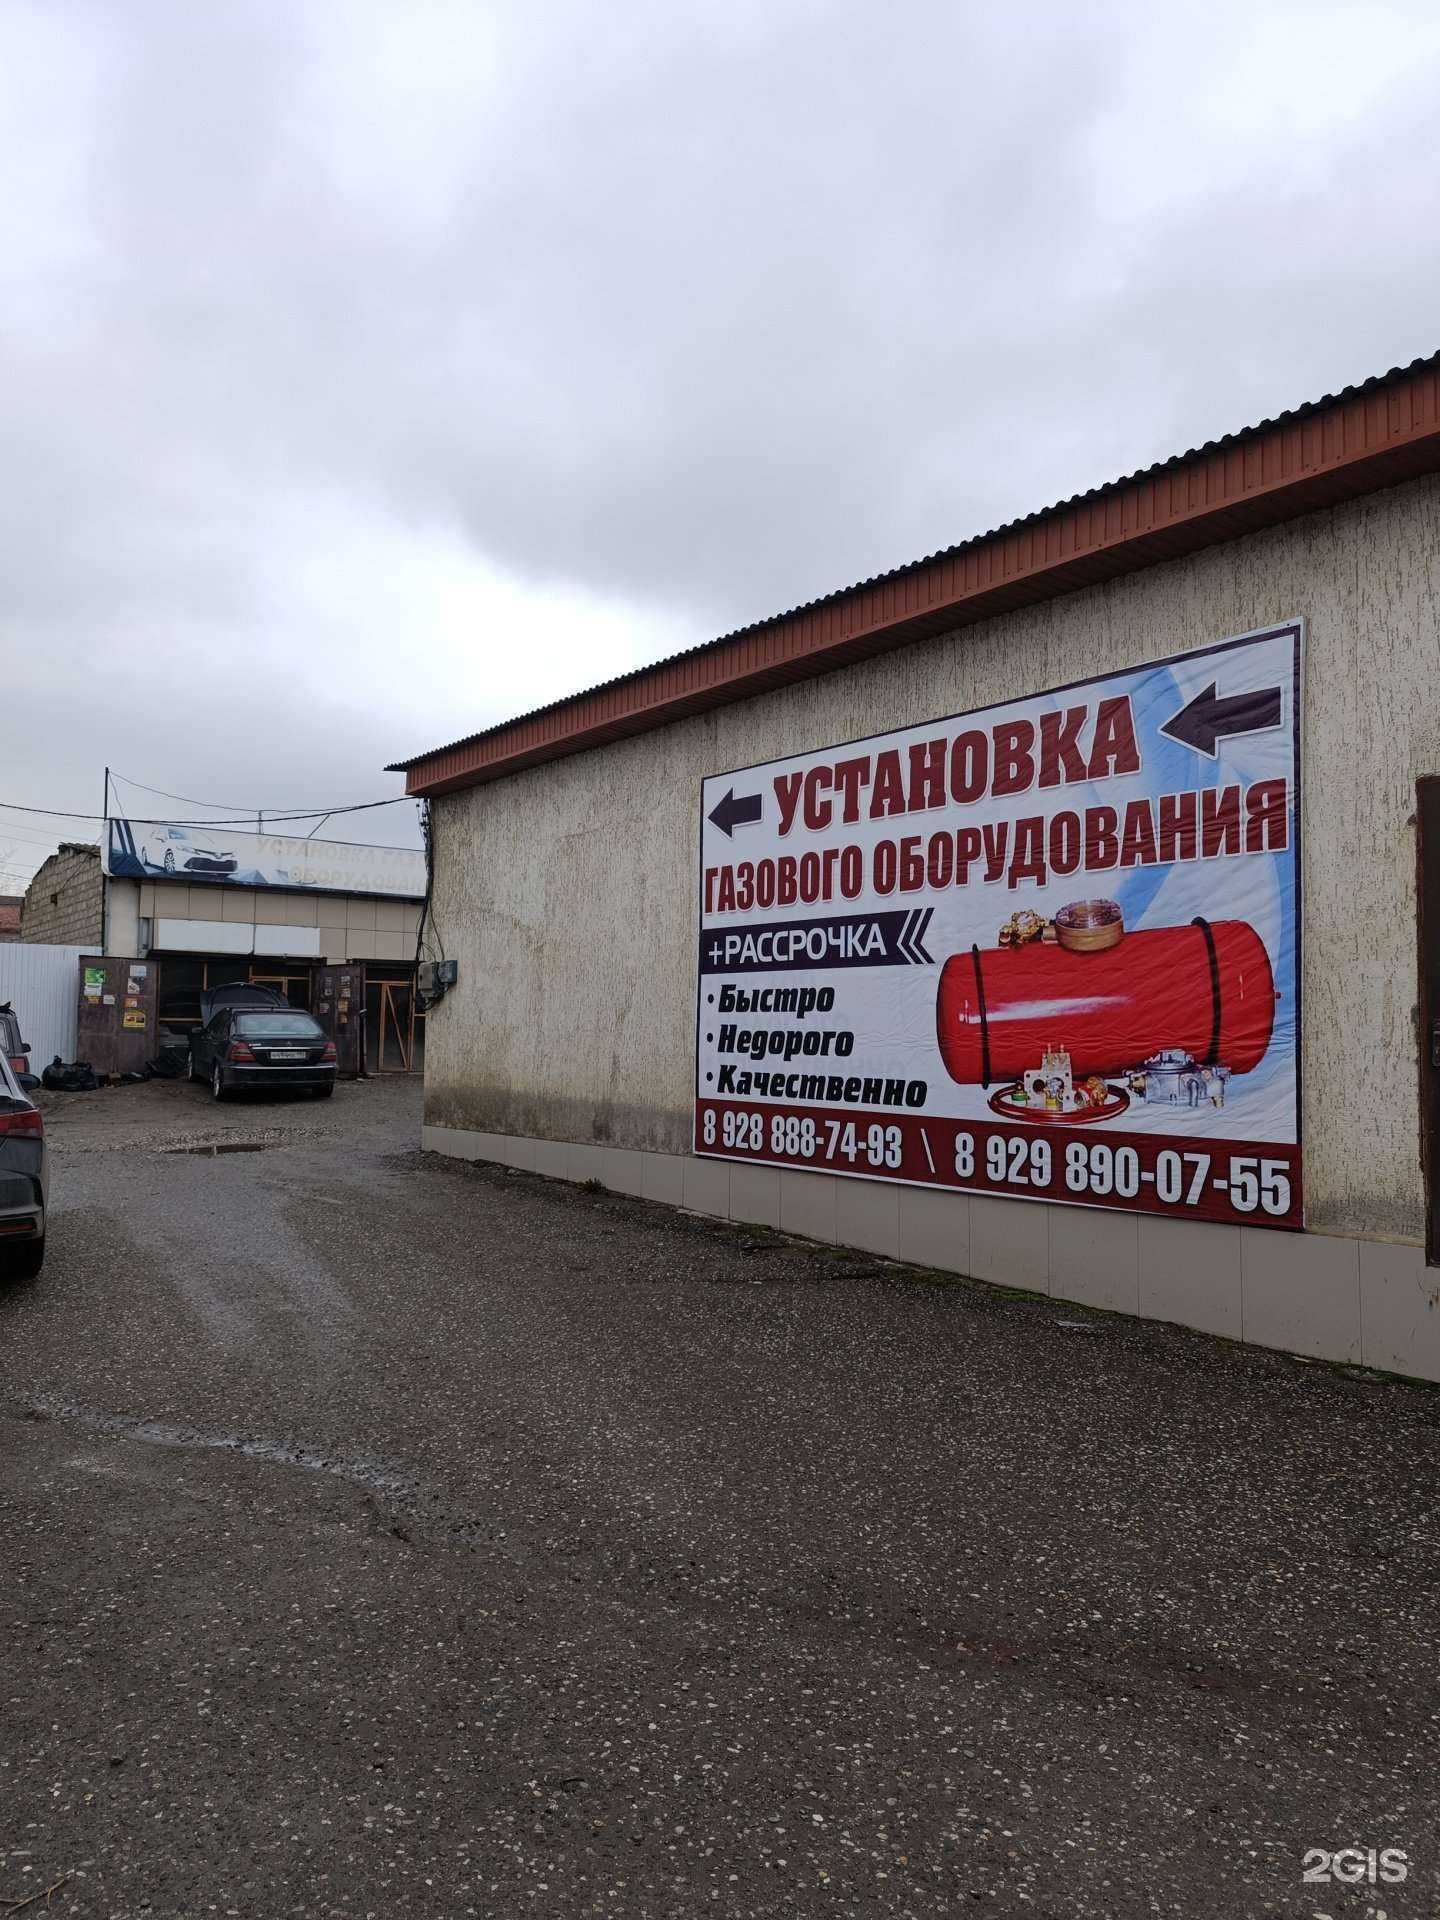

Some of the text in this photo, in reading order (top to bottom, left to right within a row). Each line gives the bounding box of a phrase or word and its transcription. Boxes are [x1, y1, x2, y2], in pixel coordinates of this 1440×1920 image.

[773, 695, 1141, 836] УСТАНОВКА
[704, 778, 1287, 914] ГАЗОВОГО ОБОРУДОВАНИЯ
[708, 922, 888, 966] +РАССРОЧКА
[717, 983, 836, 1019] Быстро
[716, 1023, 855, 1062] Недорого
[716, 1064, 928, 1108] Качественно
[703, 1108, 717, 1145] 8
[722, 1110, 764, 1151] 928
[770, 1114, 903, 1169] 888-74-93
[954, 1131, 975, 1178] 8
[986, 1136, 1052, 1188] 929
[1065, 1141, 1291, 1216] 890-07-55
